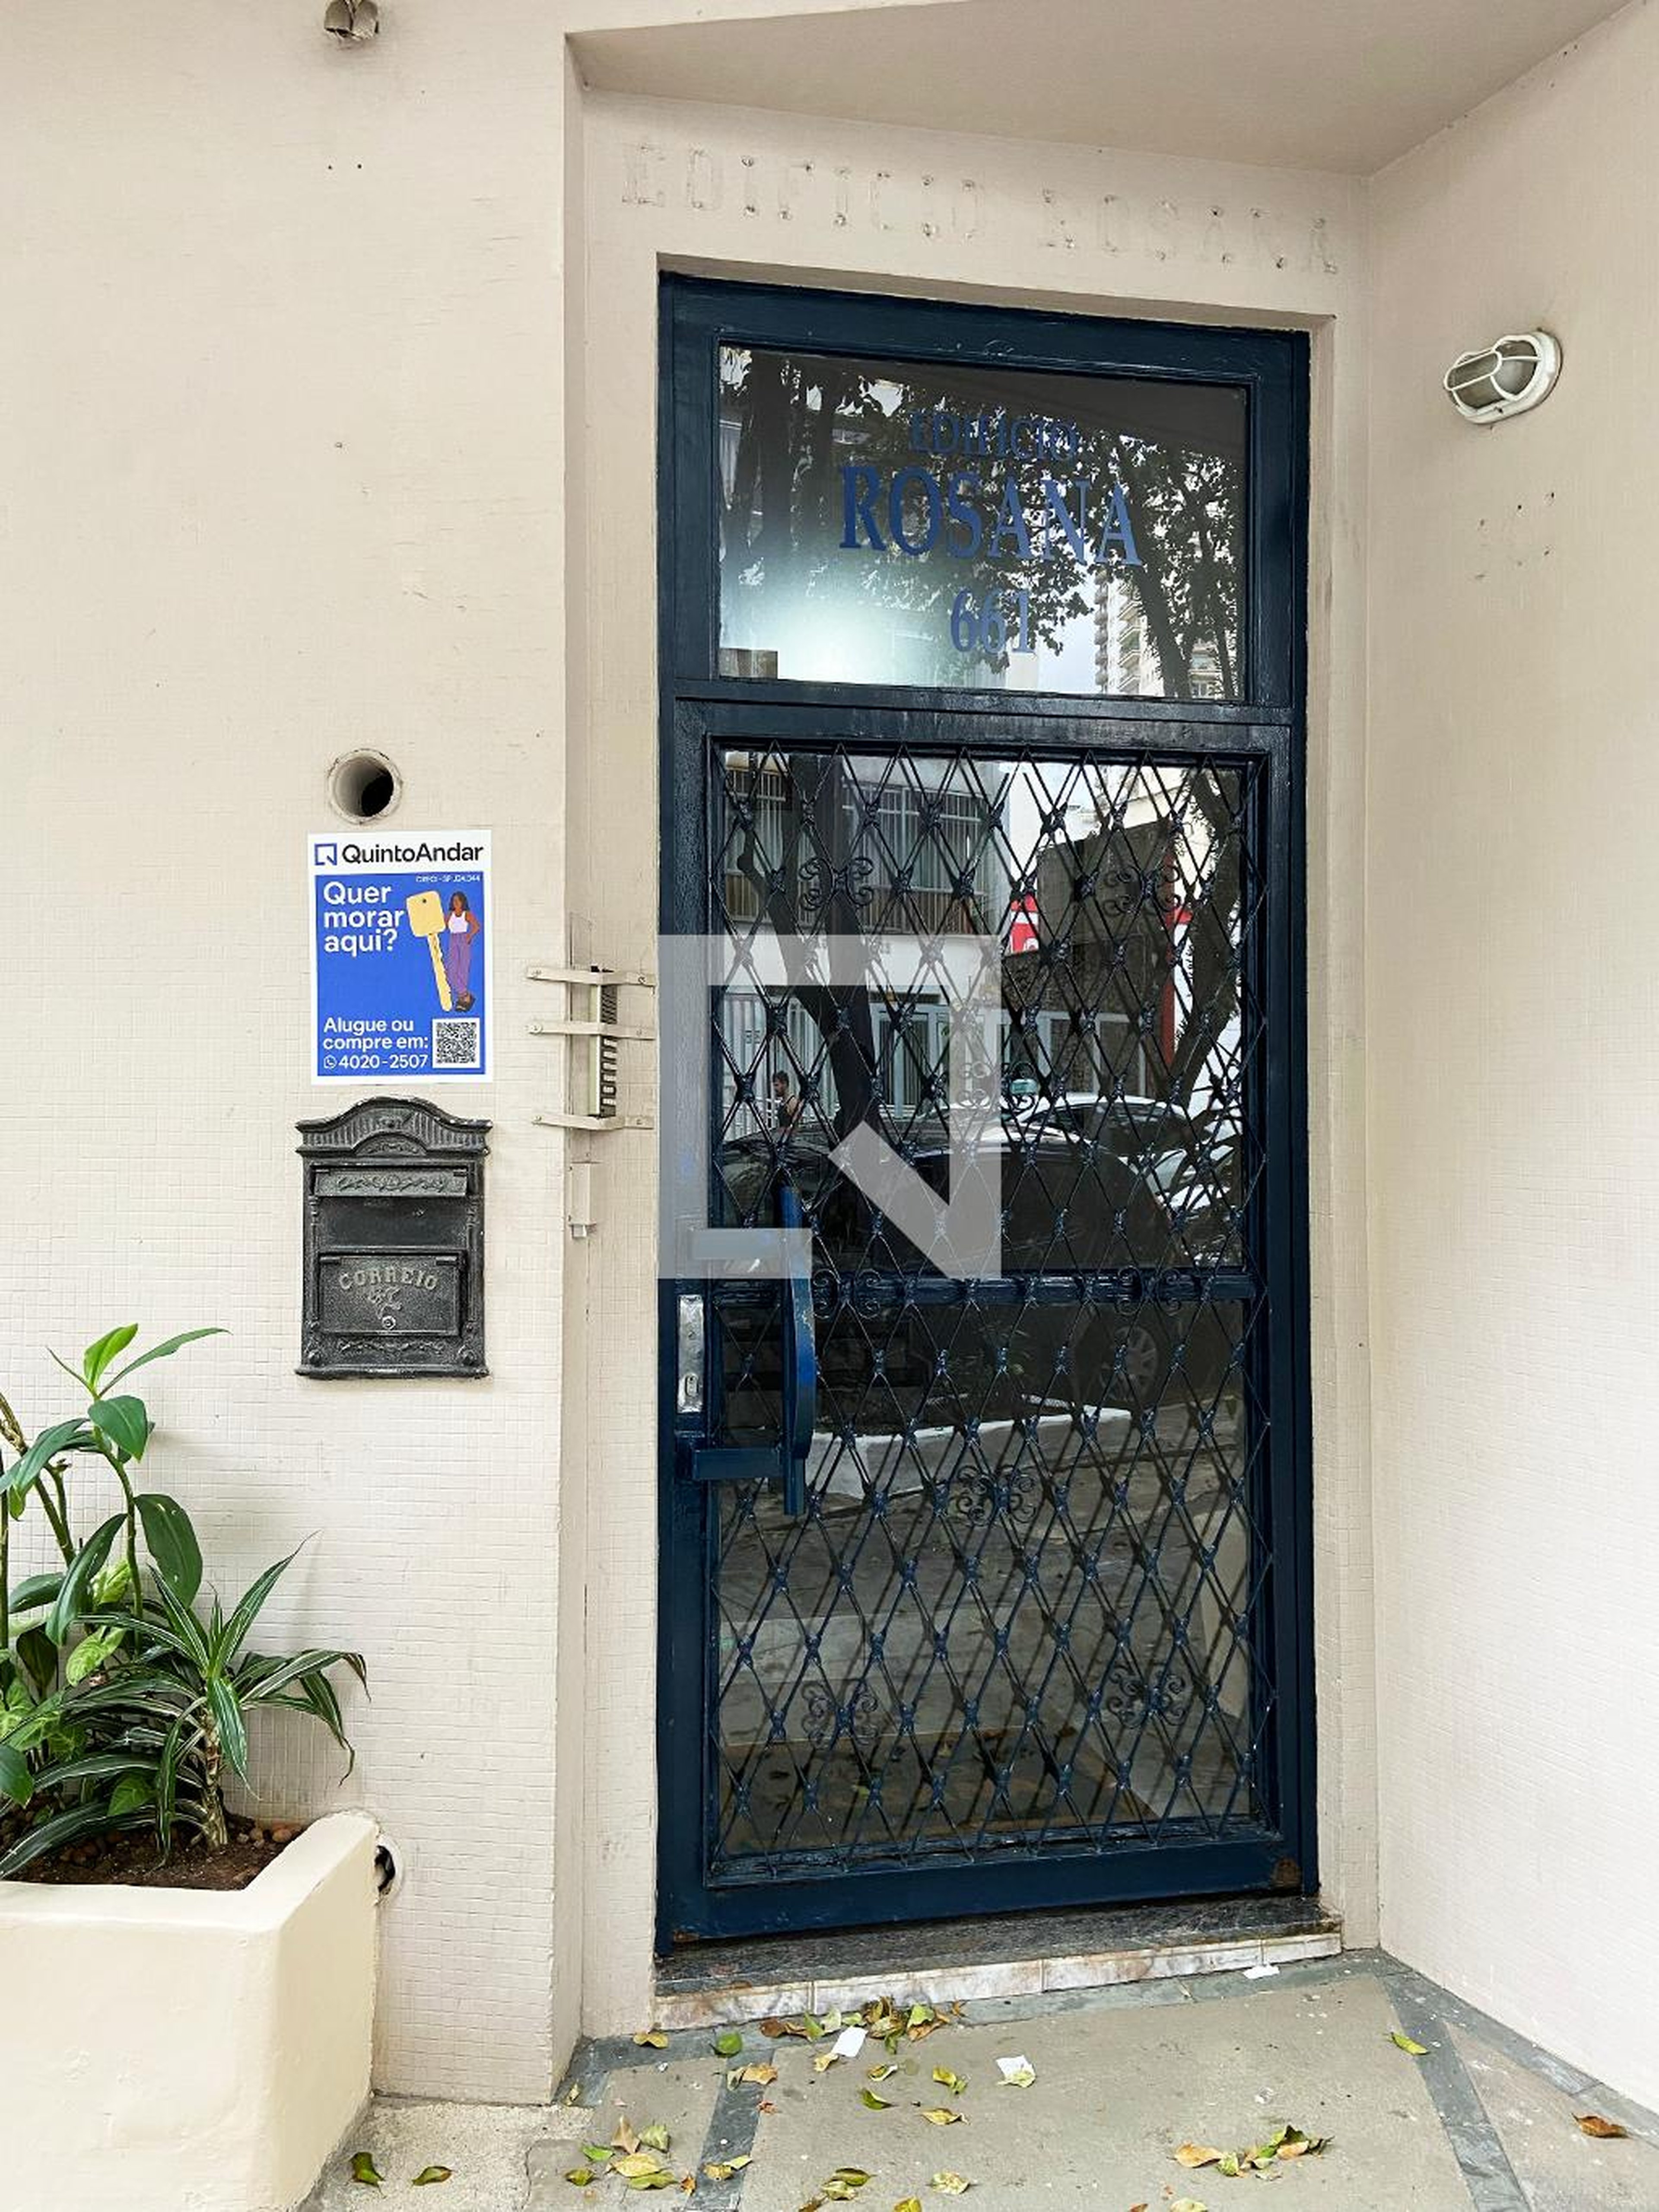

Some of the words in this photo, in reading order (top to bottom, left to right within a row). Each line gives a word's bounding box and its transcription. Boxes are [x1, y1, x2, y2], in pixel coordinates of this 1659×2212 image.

[839, 465, 1142, 566] ROSANA
[951, 588, 1035, 653] 661
[342, 843, 483, 863] QuintoAndar
[323, 882, 391, 905] Quer
[324, 909, 404, 928] morar
[324, 929, 397, 957] aqui?
[323, 1017, 387, 1034] Alugue
[391, 1021, 414, 1032] ou
[323, 1037, 392, 1052] compre
[396, 1037, 429, 1048] em:
[338, 1054, 428, 1069] 4020-2507
[339, 1267, 437, 1290] CORREIO
